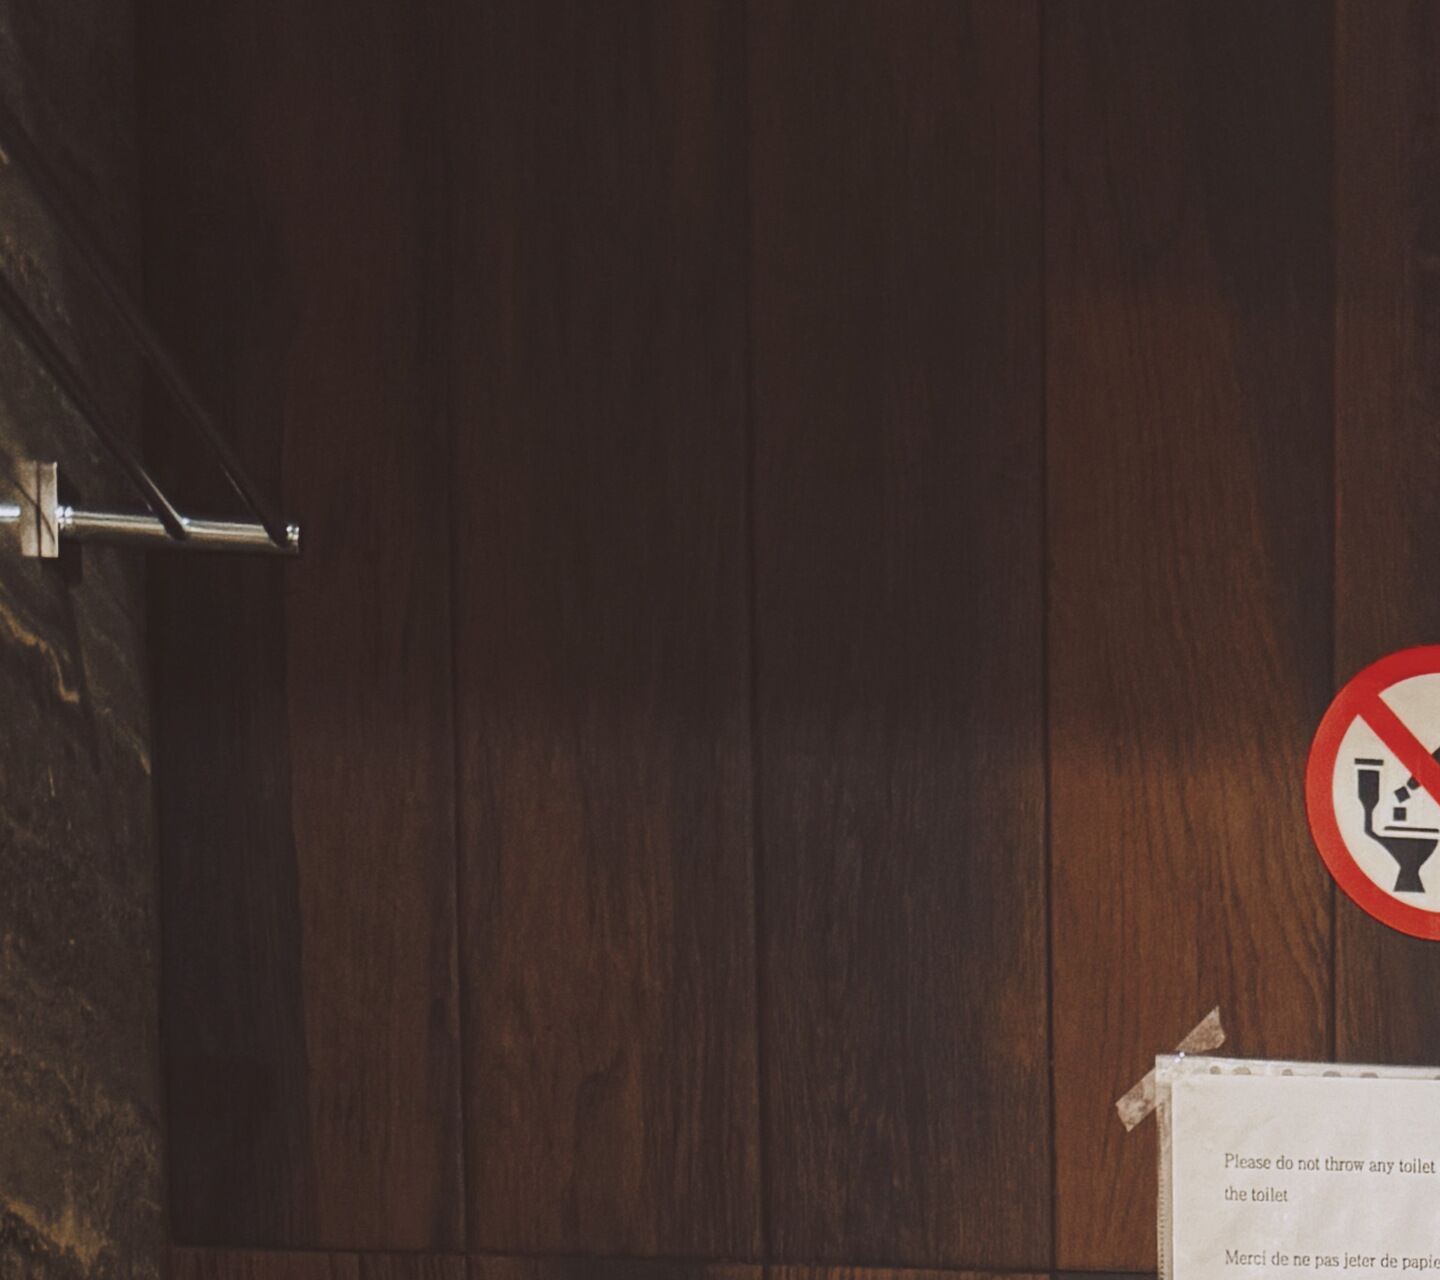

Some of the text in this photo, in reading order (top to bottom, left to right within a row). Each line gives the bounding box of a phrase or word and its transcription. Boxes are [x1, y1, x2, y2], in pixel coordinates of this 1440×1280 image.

[1225, 1152, 1271, 1170] Please
[1276, 1154, 1294, 1171] do
[1298, 1158, 1320, 1171] not
[1325, 1156, 1365, 1172] throw
[1369, 1161, 1394, 1176] any
[1399, 1158, 1436, 1175] toilet
[1225, 1186, 1288, 1203] the toilet
[1225, 1249, 1266, 1266] Merci
[1271, 1251, 1289, 1267] de
[1293, 1254, 1310, 1267] ne
[1315, 1255, 1340, 1270] pas
[1343, 1252, 1377, 1270] jeter
[1380, 1253, 1398, 1269] de
